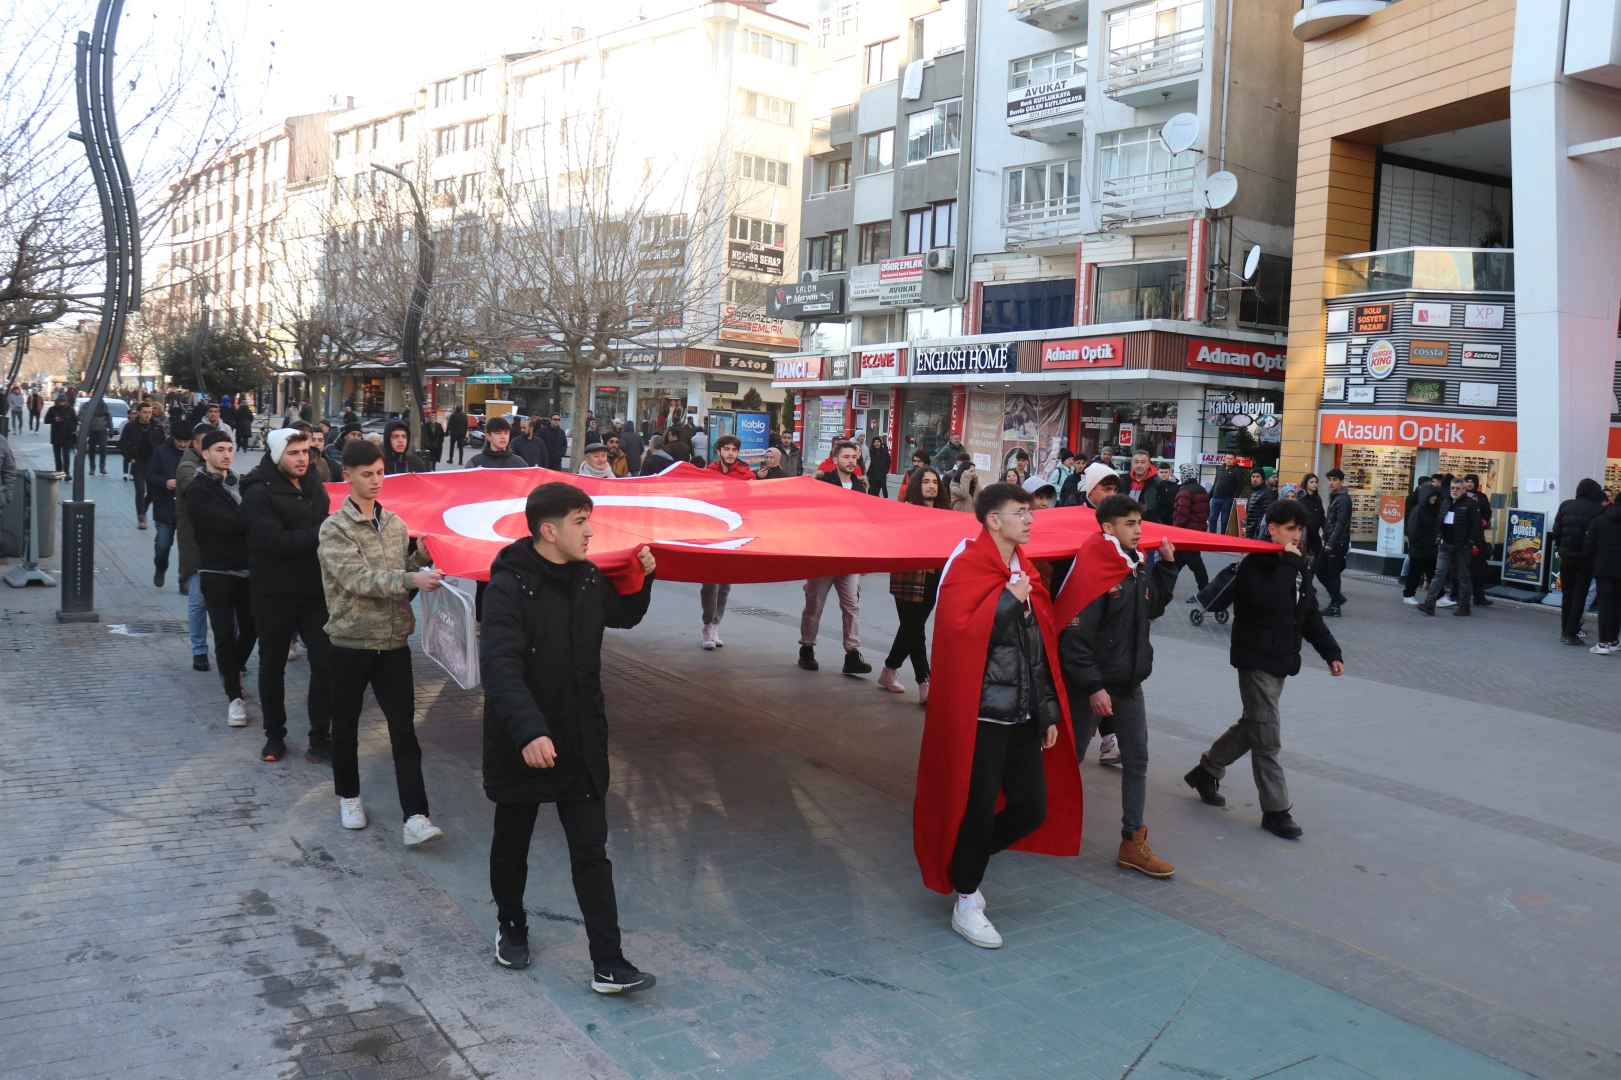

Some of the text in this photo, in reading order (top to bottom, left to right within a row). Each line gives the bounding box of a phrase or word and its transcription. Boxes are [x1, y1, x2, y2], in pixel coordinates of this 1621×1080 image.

[1025, 80, 1067, 97] AVUKAT
[900, 259, 922, 270] EMLAK
[796, 285, 816, 294] SALON
[889, 285, 916, 293] AVUKAT
[794, 294, 818, 303] Meryem
[1358, 315, 1386, 323] SOSYETE
[1476, 308, 1494, 319] XP
[752, 323, 784, 334] EMLAK
[916, 347, 1008, 371] ENGLISH HOME
[1045, 344, 1114, 363] Adnan Optik
[1196, 346, 1286, 372] Adnan Opti
[1372, 350, 1392, 358] BURGER
[862, 352, 895, 368] ECZANE
[1370, 356, 1392, 367] KING
[776, 362, 808, 378] HANCI
[858, 391, 868, 406] E
[987, 402, 1000, 412] HOME
[742, 420, 765, 428] Kablo
[1335, 420, 1485, 446] Atasun Optik 2
[1513, 525, 1536, 536] BURGER
